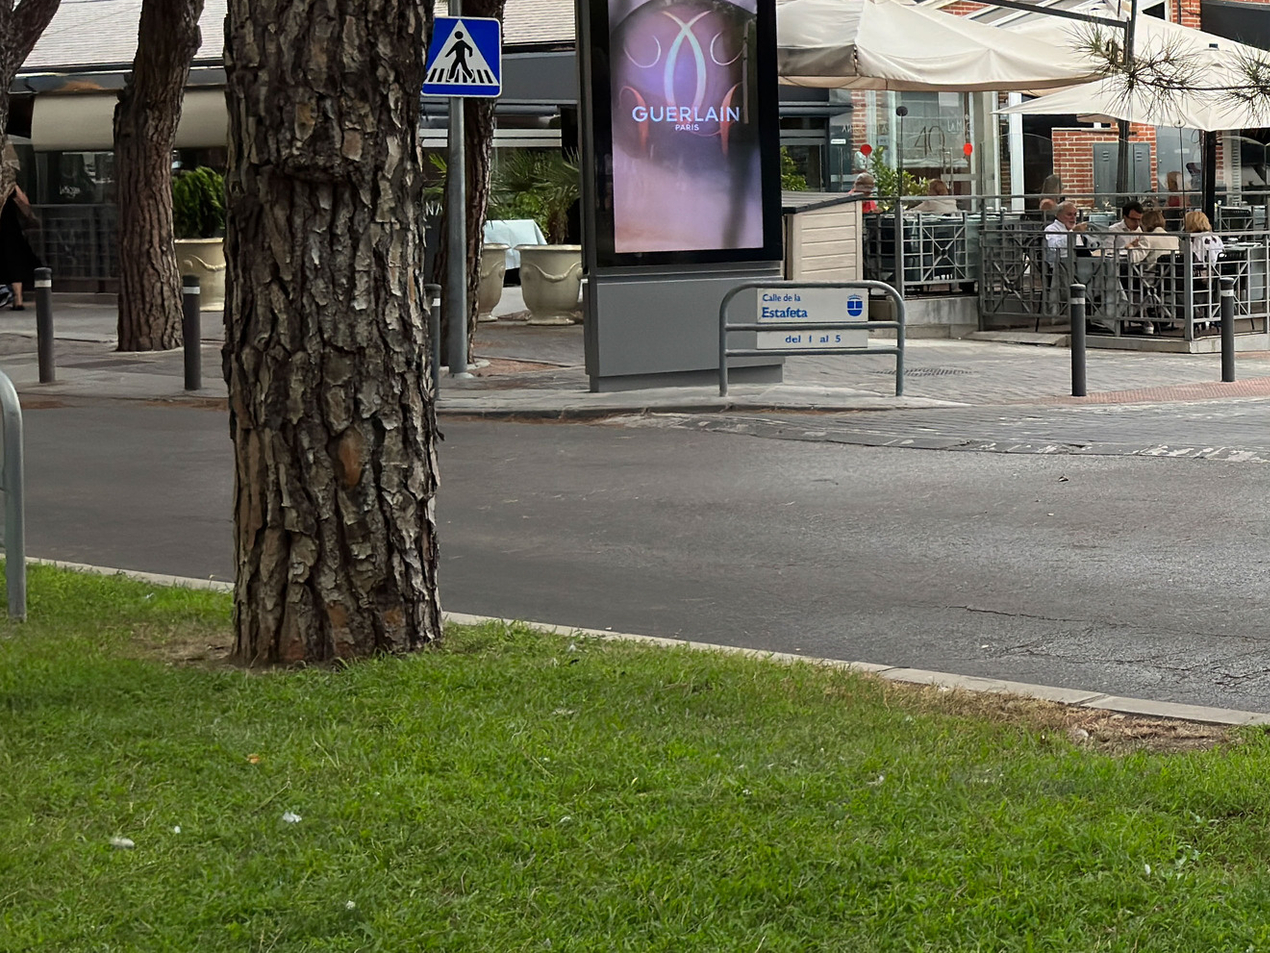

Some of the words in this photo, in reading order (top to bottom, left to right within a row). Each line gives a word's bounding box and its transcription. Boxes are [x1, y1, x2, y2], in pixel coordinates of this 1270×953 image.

[631, 105, 740, 123] GUERLAIN
[674, 123, 700, 131] PARIS
[762, 293, 782, 302] Calle
[783, 293, 793, 302] de
[794, 294, 801, 302] la
[761, 306, 808, 318] Estafeta
[785, 335, 801, 343] del
[820, 335, 829, 343] al
[834, 334, 841, 343] 5
